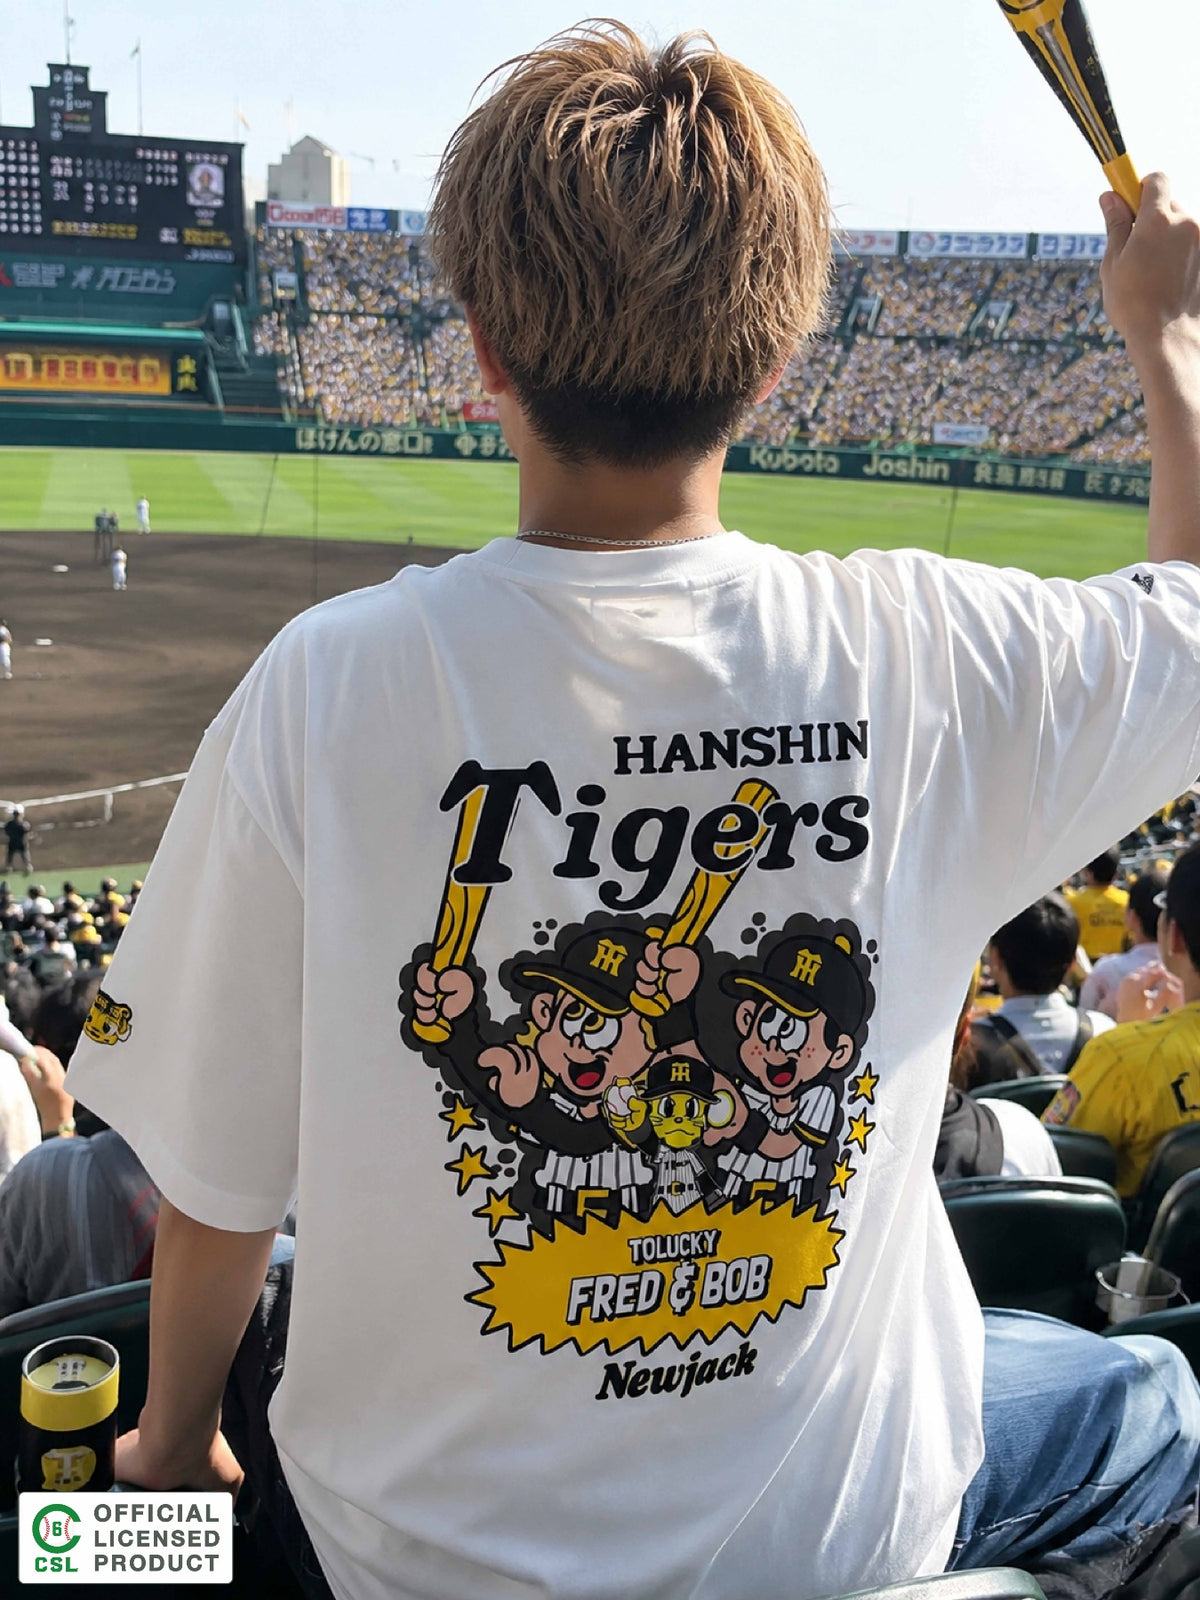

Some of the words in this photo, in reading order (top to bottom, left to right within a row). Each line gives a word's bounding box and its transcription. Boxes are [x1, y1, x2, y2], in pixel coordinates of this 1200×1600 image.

[749, 446, 840, 474] Kubota
[862, 452, 950, 481] Joshin
[613, 720, 869, 775] HANSHIN
[439, 760, 870, 911] Tigers
[628, 1229, 721, 1264] TOLUCKY
[566, 1272, 665, 1326] FRED
[670, 1259, 700, 1316] &
[700, 1255, 773, 1307] BOB
[595, 1342, 758, 1400] Newjack
